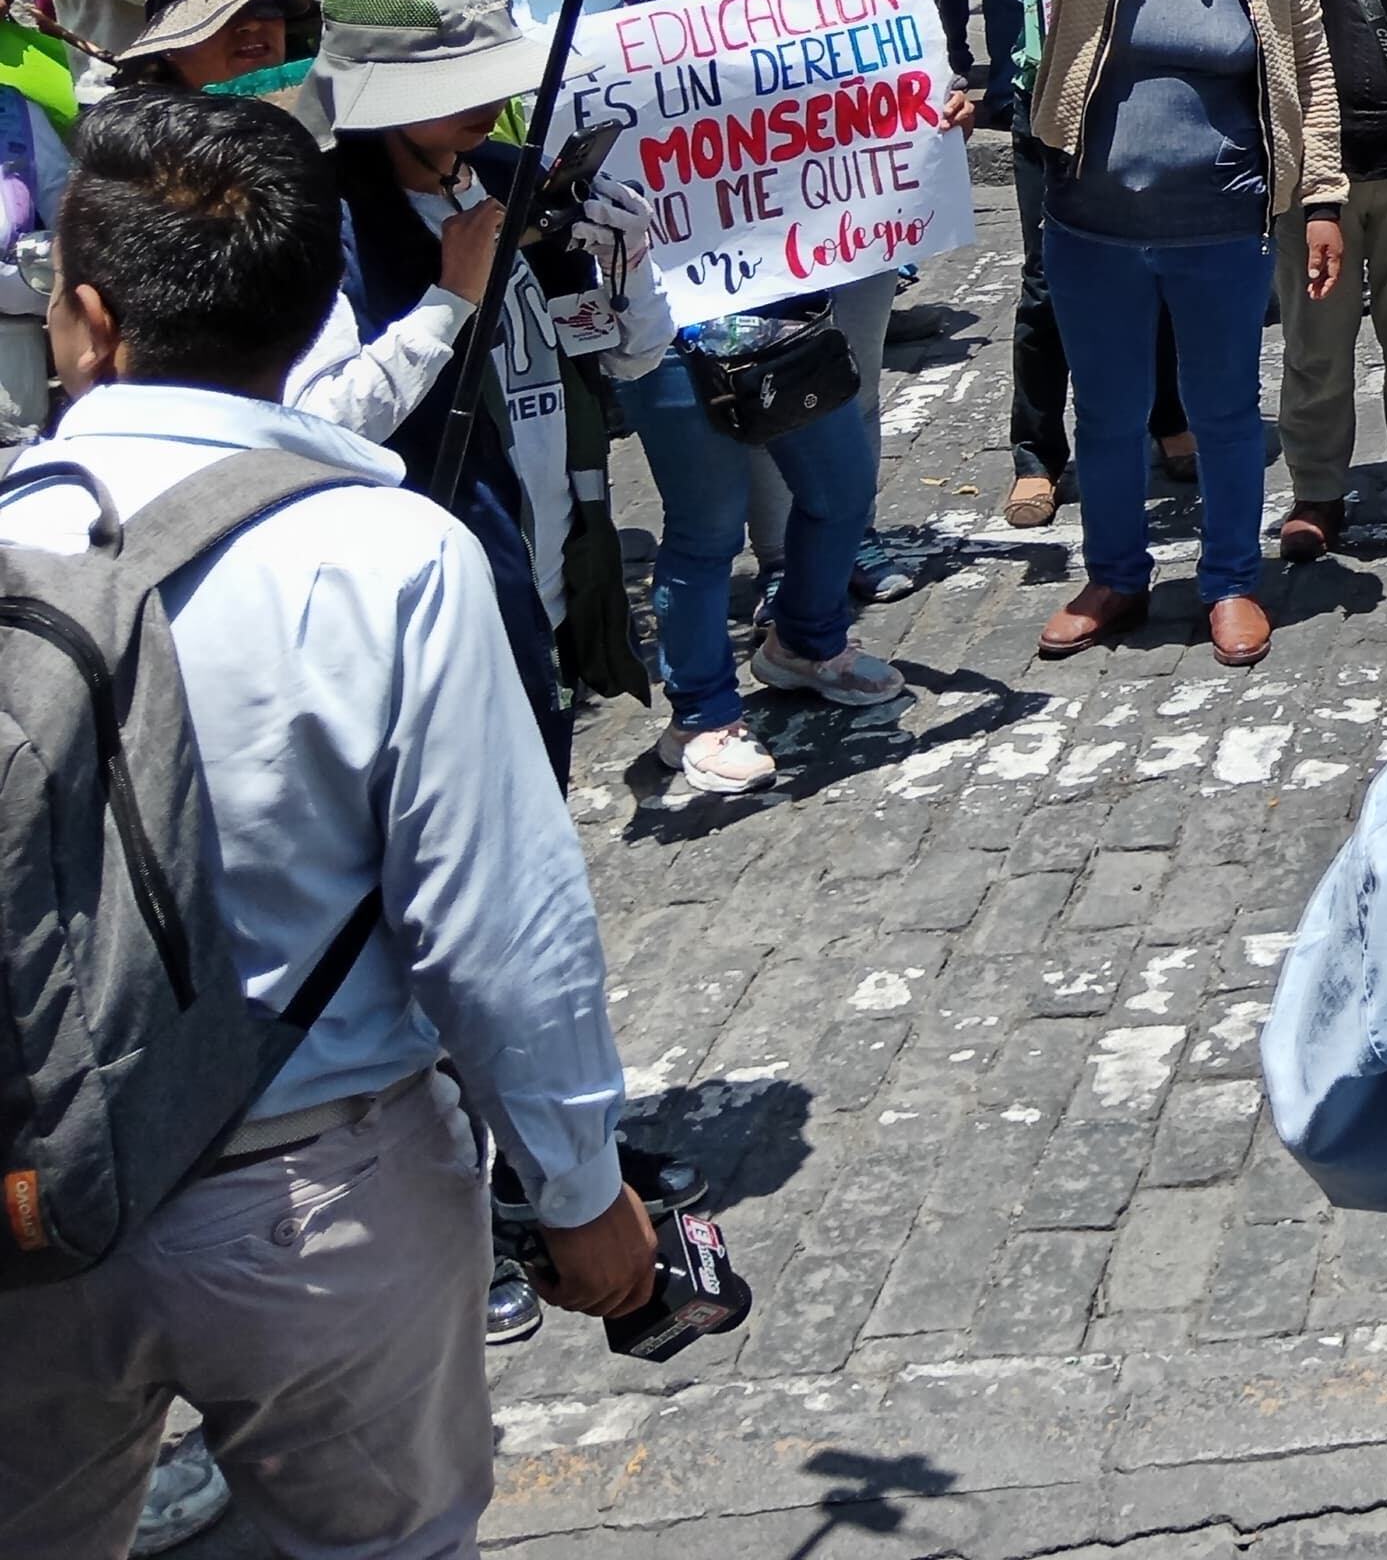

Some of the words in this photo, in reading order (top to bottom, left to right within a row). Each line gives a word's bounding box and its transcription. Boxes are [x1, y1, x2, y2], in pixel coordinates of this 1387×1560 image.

[574, 81, 638, 130] ES
[654, 60, 722, 119] UN
[751, 15, 924, 96] DERECHO
[640, 71, 939, 192] MONSEÑOR
[715, 168, 784, 229] ME
[801, 141, 920, 209] QUITE
